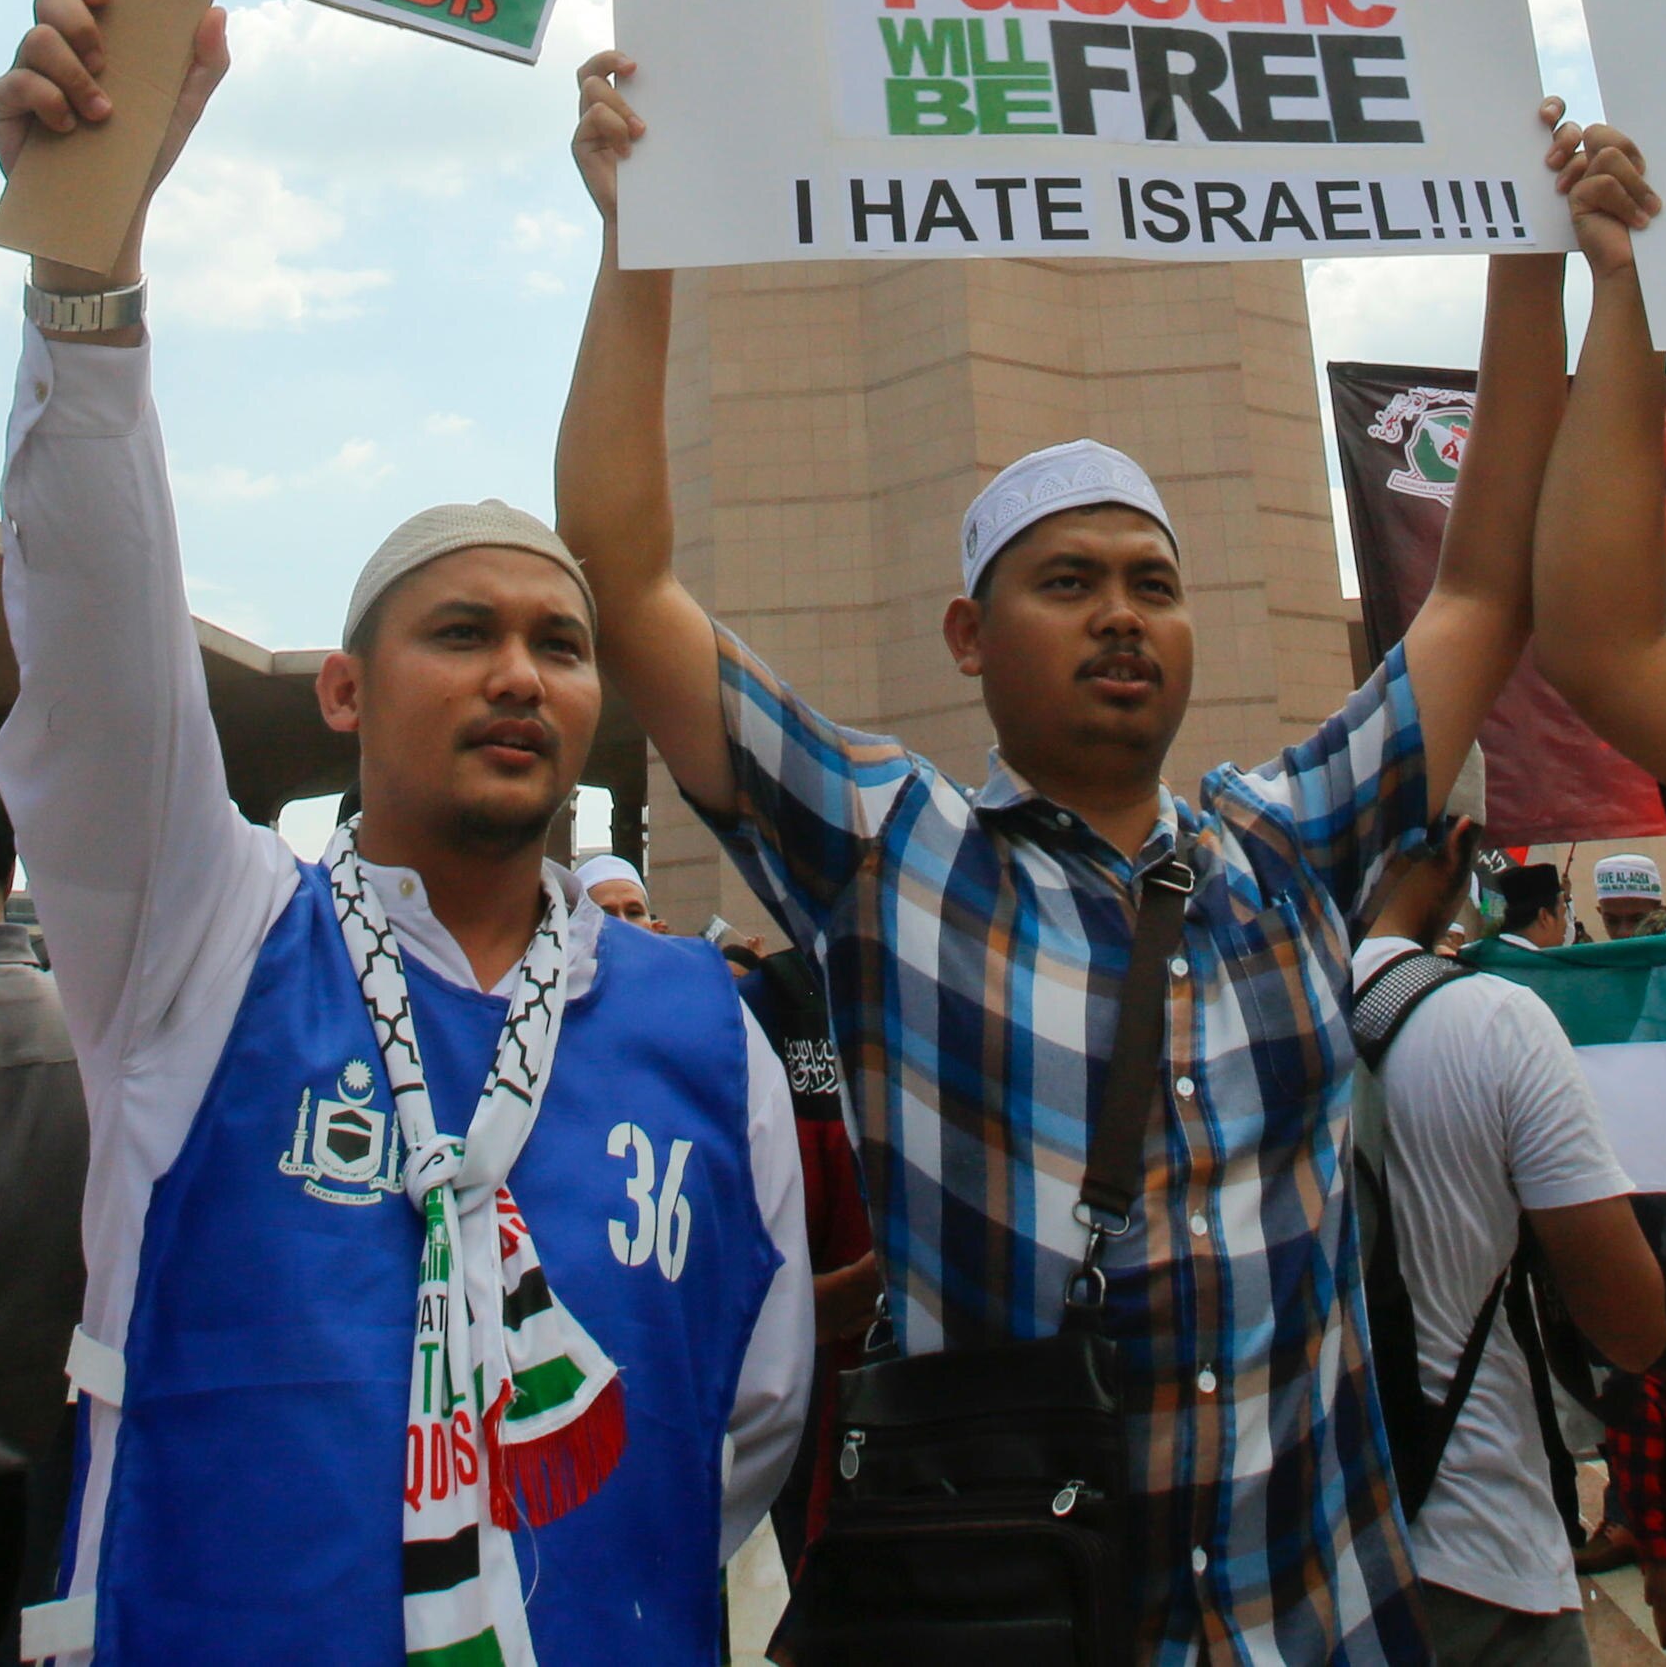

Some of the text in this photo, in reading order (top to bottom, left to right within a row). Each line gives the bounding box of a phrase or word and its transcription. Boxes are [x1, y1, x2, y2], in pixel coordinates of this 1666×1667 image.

[878, 16, 1050, 78] WILL
[884, 20, 1425, 144] BE FREE
[795, 179, 815, 245] I
[850, 176, 1090, 244] HATE
[606, 1121, 693, 1283] 36
